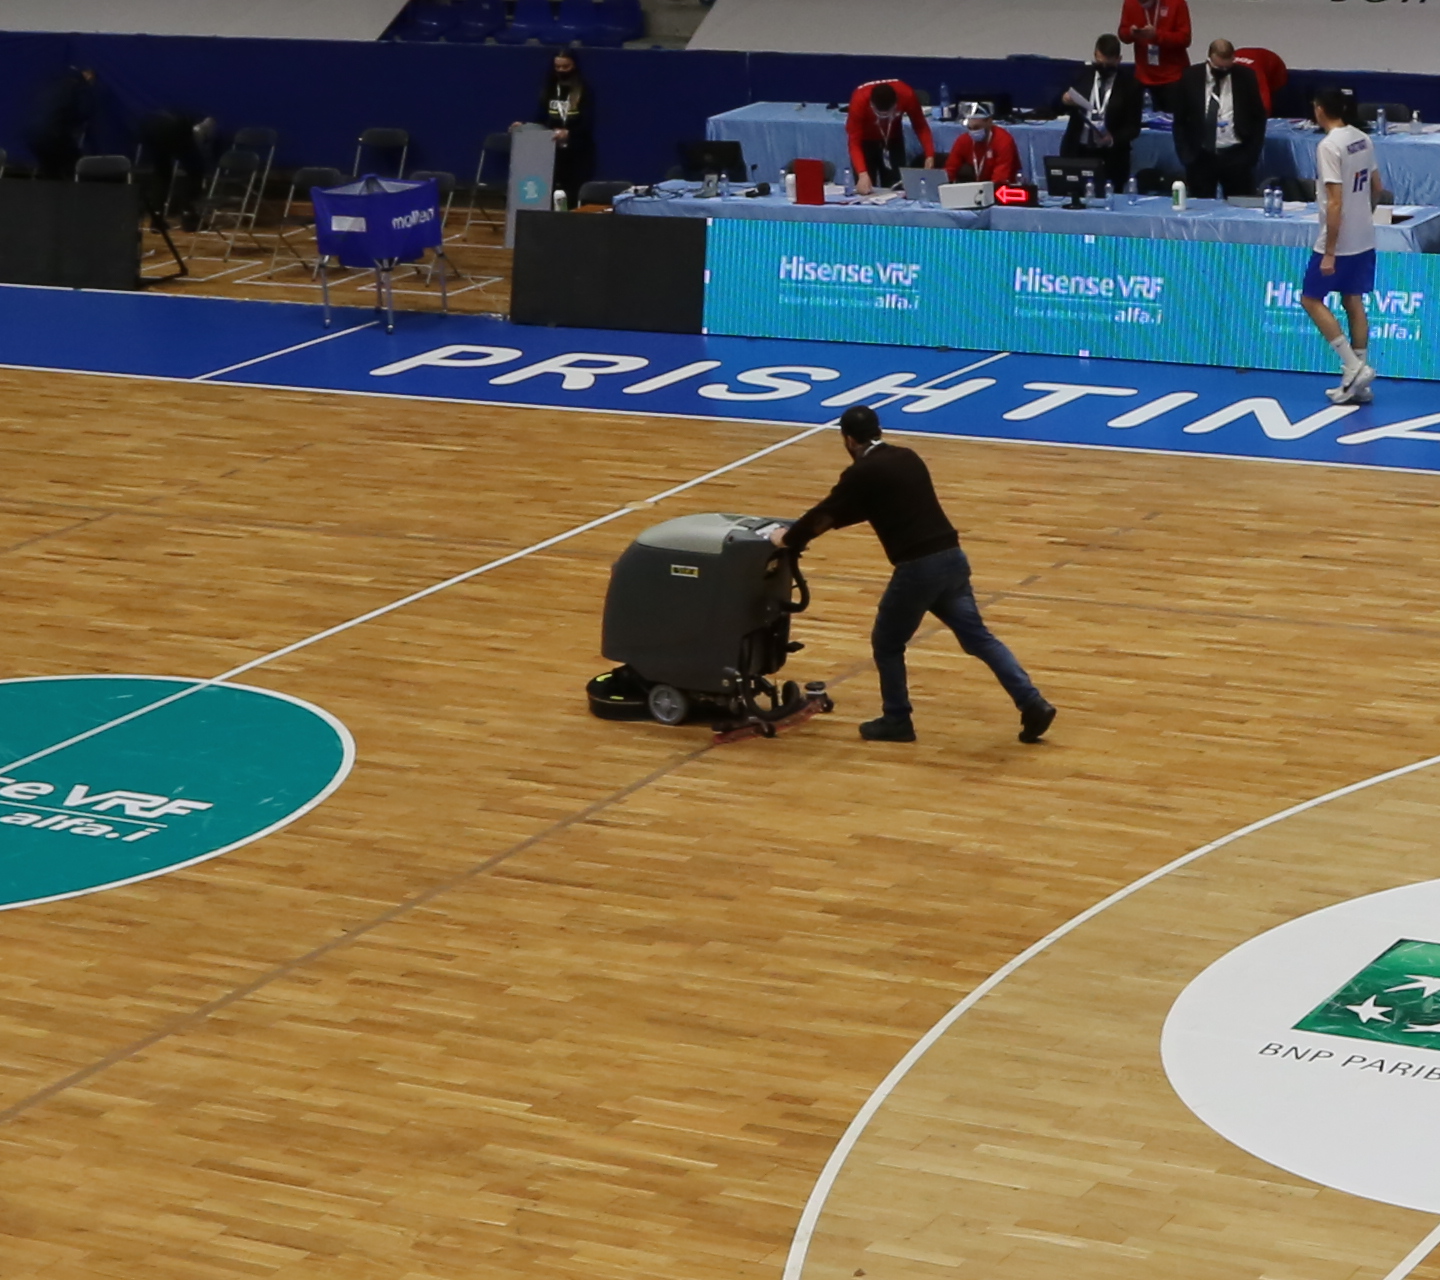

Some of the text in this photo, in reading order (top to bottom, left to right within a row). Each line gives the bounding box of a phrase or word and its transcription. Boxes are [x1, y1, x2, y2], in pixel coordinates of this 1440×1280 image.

[391, 205, 436, 230] molten
[778, 254, 922, 287] Hisense VRF
[1013, 266, 1166, 301] Hisense VRF
[1373, 289, 1424, 315] VRF
[61, 782, 216, 819] VRF
[1257, 1041, 1335, 1064] BNP
